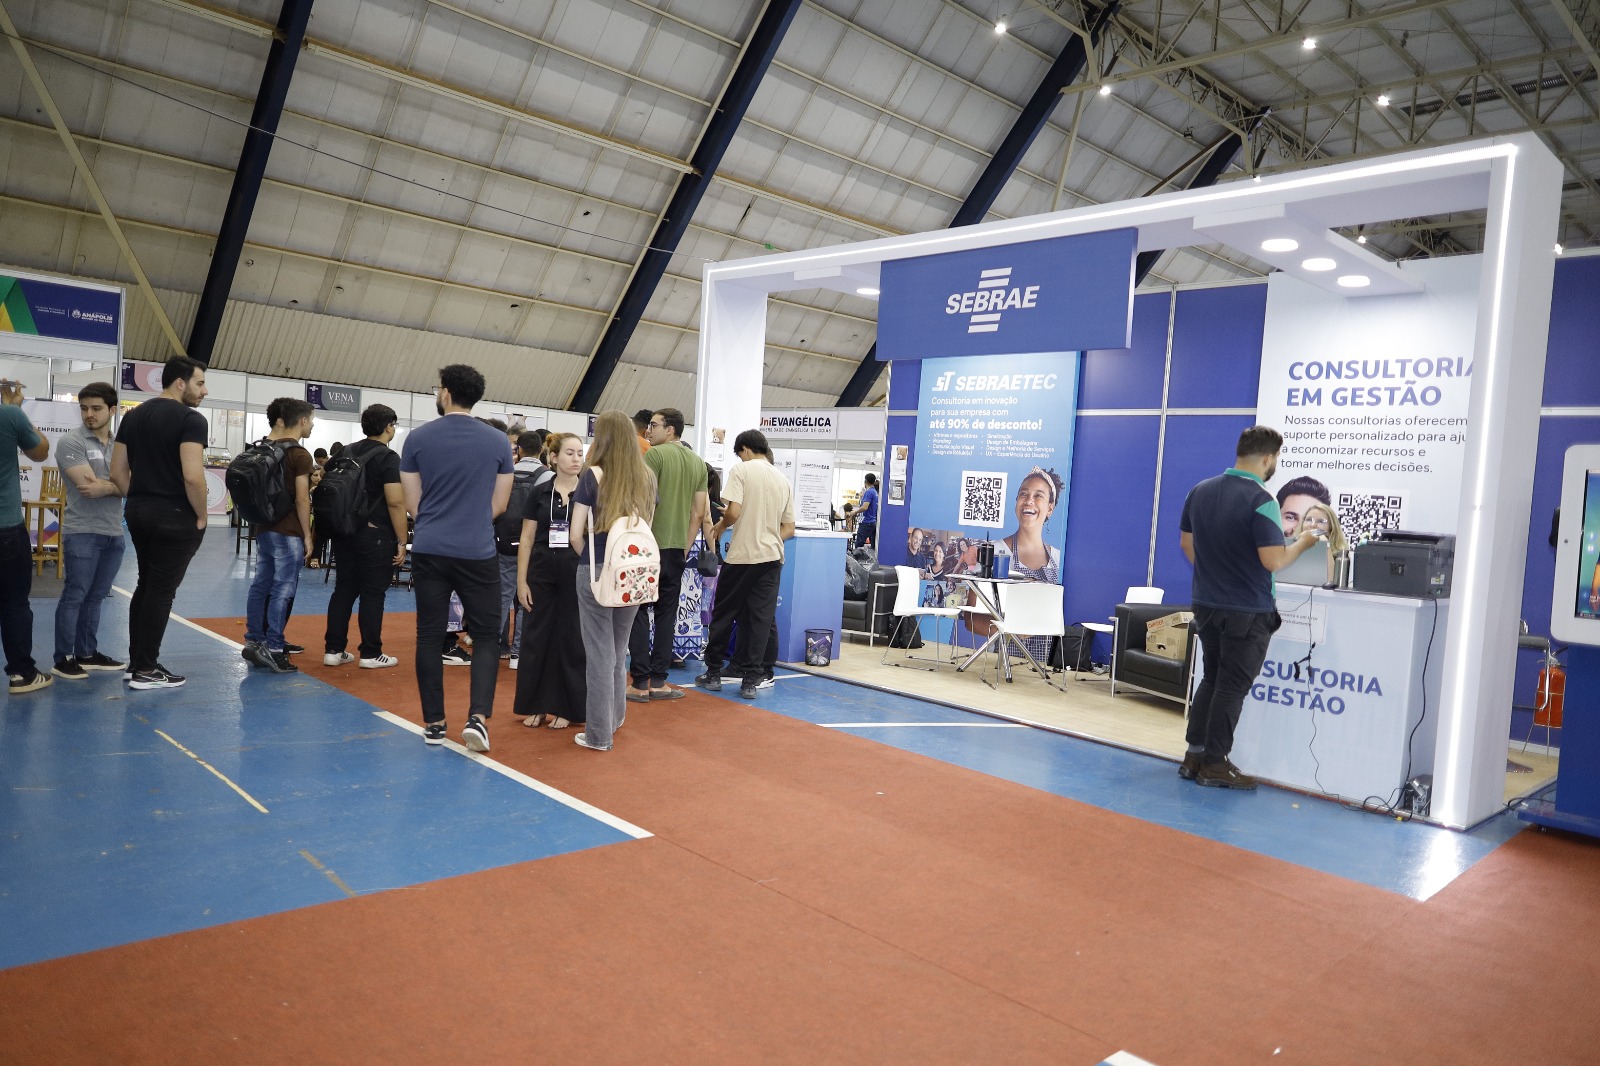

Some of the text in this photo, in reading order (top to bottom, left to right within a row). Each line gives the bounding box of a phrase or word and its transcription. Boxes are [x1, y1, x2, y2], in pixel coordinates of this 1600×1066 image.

[945, 285, 1040, 314] SEBRAE
[955, 374, 1057, 391] SEBRAETEC
[328, 391, 354, 403] VENA
[1286, 380, 1442, 406] EM GESTÃO
[931, 396, 970, 405] Consultoria
[984, 396, 1018, 406] inovação
[930, 409, 945, 417] para
[959, 409, 990, 417] empresa
[929, 419, 1043, 430] até 90% de desconto!
[1284, 415, 1468, 426] Nossas consultorias oferecem
[1283, 430, 1327, 442] suporte
[1329, 430, 1414, 442] personalizado
[1417, 433, 1446, 443] para
[1281, 444, 1426, 457] a economizar recursos e
[1280, 459, 1433, 473] tomar melhores decisões.
[1251, 683, 1346, 715] GESTÃO
